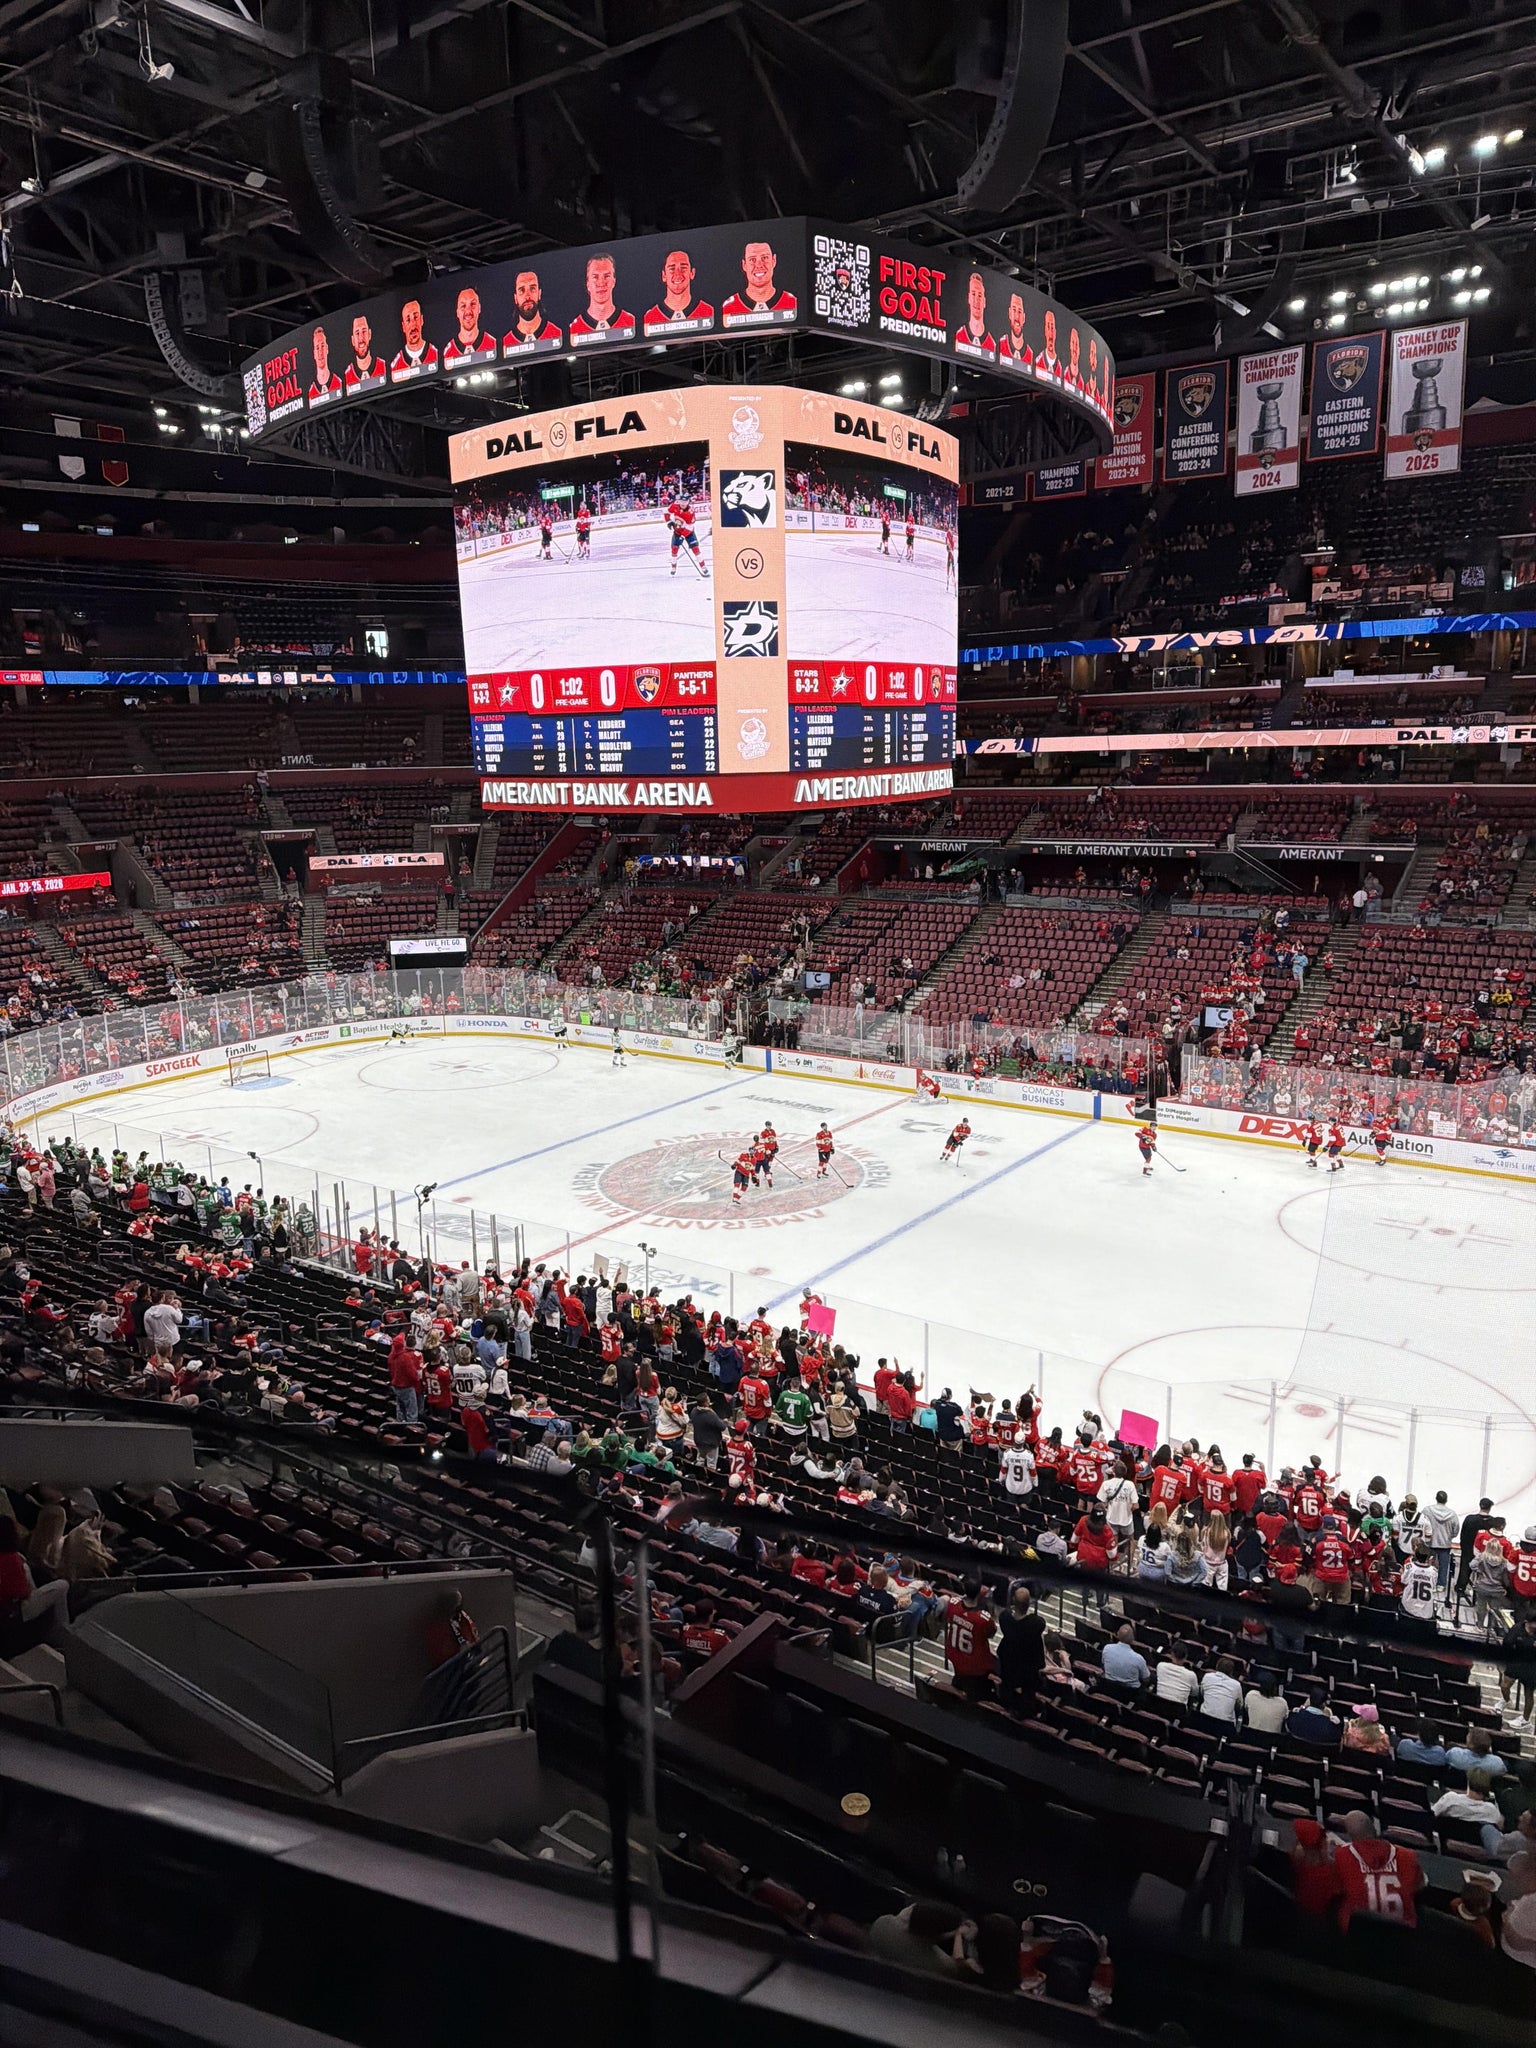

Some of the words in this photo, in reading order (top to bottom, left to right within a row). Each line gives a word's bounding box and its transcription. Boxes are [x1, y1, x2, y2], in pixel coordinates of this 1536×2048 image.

[880, 255, 946, 297] FIRST
[880, 288, 947, 328] GOAL
[880, 316, 947, 344] PREDICTION
[1397, 330, 1438, 348] STANLEY
[1441, 326, 1461, 339] CUP
[1331, 350, 1366, 361] FLORIDA
[1399, 340, 1457, 360] CHAMPIONS
[265, 347, 299, 385] FIRST
[1243, 355, 1279, 372] STANLEY
[1281, 352, 1299, 365] CUP
[1245, 365, 1296, 384] CHAMPIONS
[267, 374, 302, 409] GOAL
[269, 398, 304, 423] PREDICTION
[1325, 396, 1364, 412] EASTERN
[1316, 408, 1371, 426] CONFERENCE
[486, 430, 543, 460] DAL
[553, 430, 564, 440] VS
[574, 410, 648, 442] FLA
[834, 411, 886, 444] DAL
[894, 433, 902, 442] VS
[907, 431, 941, 462] FLA
[1178, 422, 1213, 436] EASTERN
[1317, 421, 1369, 438] CHAMPIONS
[1113, 432, 1142, 445] TLANTIC
[1171, 433, 1220, 449] CONFERENCE
[1324, 435, 1361, 450] 2024-25
[1102, 454, 1146, 468] CHAMPIONS
[1172, 446, 1218, 461] CHAMPIONS
[1178, 459, 1211, 472] 2023-24
[1405, 454, 1440, 471] 2025
[1040, 465, 1080, 480] CHAMPIONS
[1108, 467, 1139, 480] 2023-24
[1252, 471, 1281, 488] 2024
[985, 486, 1014, 498] 2021-22
[1045, 478, 1074, 491] 2022-23
[740, 558, 758, 570] VS
[1191, 629, 1243, 647] VS
[218, 674, 254, 683] DAL
[301, 673, 335, 683] FLA
[674, 671, 714, 680] PANTHERS
[865, 665, 877, 701] 0
[889, 671, 905, 689] 1:02
[531, 673, 544, 709] 0
[560, 677, 583, 696] 1:02
[600, 669, 616, 706] 0
[678, 680, 707, 696] 5-5-1
[796, 678, 819, 693] 6-3-2
[914, 667, 923, 701] 0
[555, 698, 589, 706] PRE-GAME
[808, 705, 837, 713] LEADERS
[677, 708, 715, 716] LEADERS
[556, 720, 564, 730] 31
[704, 717, 714, 727] 23
[704, 727, 715, 738] 23
[1397, 730, 1445, 741] DAL
[705, 739, 715, 749] 22
[600, 753, 622, 761] CROSBY
[705, 750, 715, 760] 22
[584, 763, 595, 771] 10.
[706, 761, 716, 771] 22
[482, 781, 571, 804] AMERANT
[572, 782, 631, 806] BANK
[633, 782, 713, 806] ARENA
[794, 775, 892, 803] AMERANT
[895, 771, 926, 795] BANK
[927, 768, 954, 791] ARENA
[921, 842, 968, 852] AMERANT
[1054, 845, 1072, 855] THE
[1075, 845, 1130, 856] AMERANT
[1133, 847, 1174, 857] VAULT
[1279, 848, 1344, 860] AMERANT
[327, 858, 358, 866] DAL
[398, 856, 427, 864] FLA
[1, 882, 19, 894] JAN.
[353, 1023, 378, 1035] Baptist
[466, 1019, 508, 1028] HONDA
[305, 1030, 330, 1038] ACTION
[634, 1034, 659, 1047] Surfside
[145, 1055, 201, 1078] SEATGEEK
[1022, 1086, 1064, 1098] COMCAST
[1022, 1094, 1065, 1106] BUSINESS
[740, 1093, 834, 1113] AutoNation
[1165, 1107, 1192, 1116] DiMaggio
[1175, 1114, 1200, 1123] Hospital
[655, 1131, 810, 1147] AMERANT
[1496, 1160, 1519, 1169] CRUISE
[572, 1161, 608, 1190] ARENA
[640, 1208, 826, 1230] AMERANT
[222, 1226, 235, 1238] 22
[427, 1380, 442, 1396] 19
[455, 1379, 474, 1393] 00
[786, 1405, 795, 1419] 4
[729, 1457, 746, 1473] 72
[1013, 1466, 1024, 1482] 9
[1077, 1464, 1098, 1483] 25
[1160, 1481, 1176, 1500] 16
[1206, 1486, 1222, 1502] 19
[1302, 1497, 1318, 1516] 16
[1321, 1549, 1344, 1569] 21
[1412, 1580, 1432, 1601] 16
[951, 1623, 973, 1654] 16
[1364, 1874, 1404, 1918] 16
